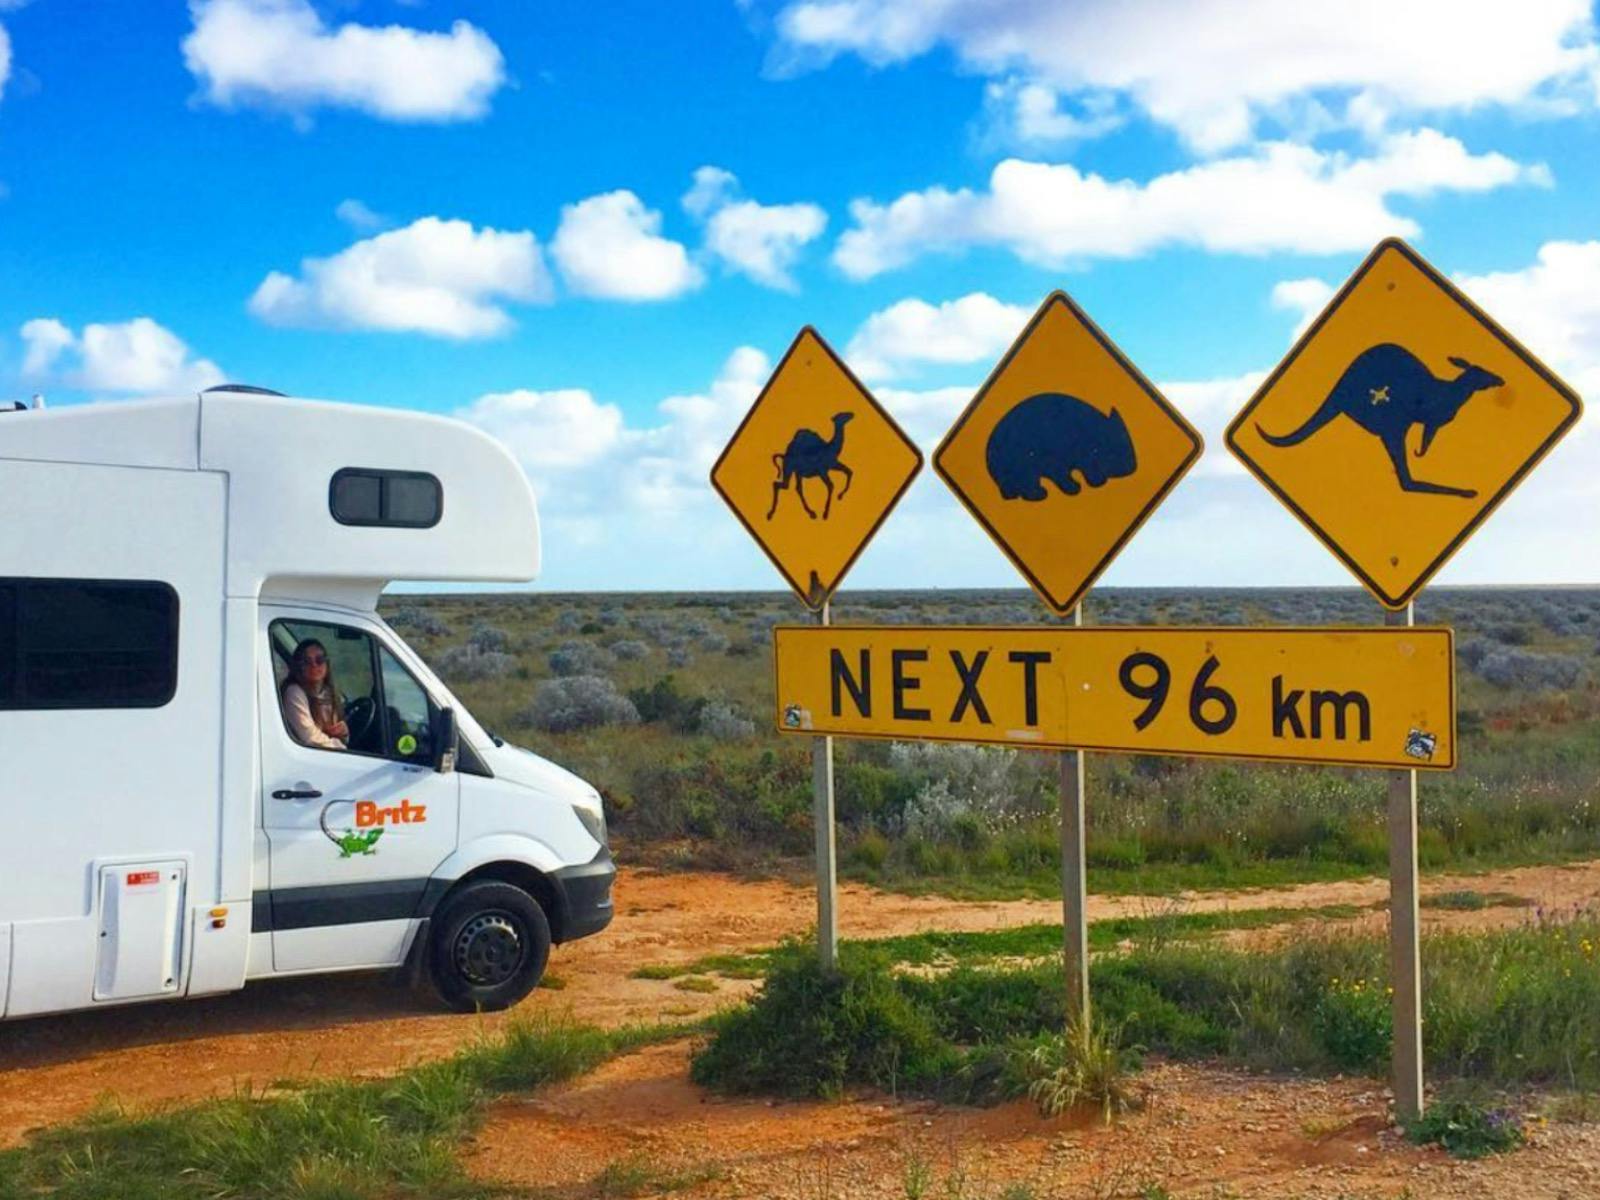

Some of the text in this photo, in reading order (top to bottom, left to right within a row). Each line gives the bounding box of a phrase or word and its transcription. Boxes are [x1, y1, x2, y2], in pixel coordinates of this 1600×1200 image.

[829, 648, 1371, 742] NEXT 96 km
[354, 799, 427, 828] Britz
